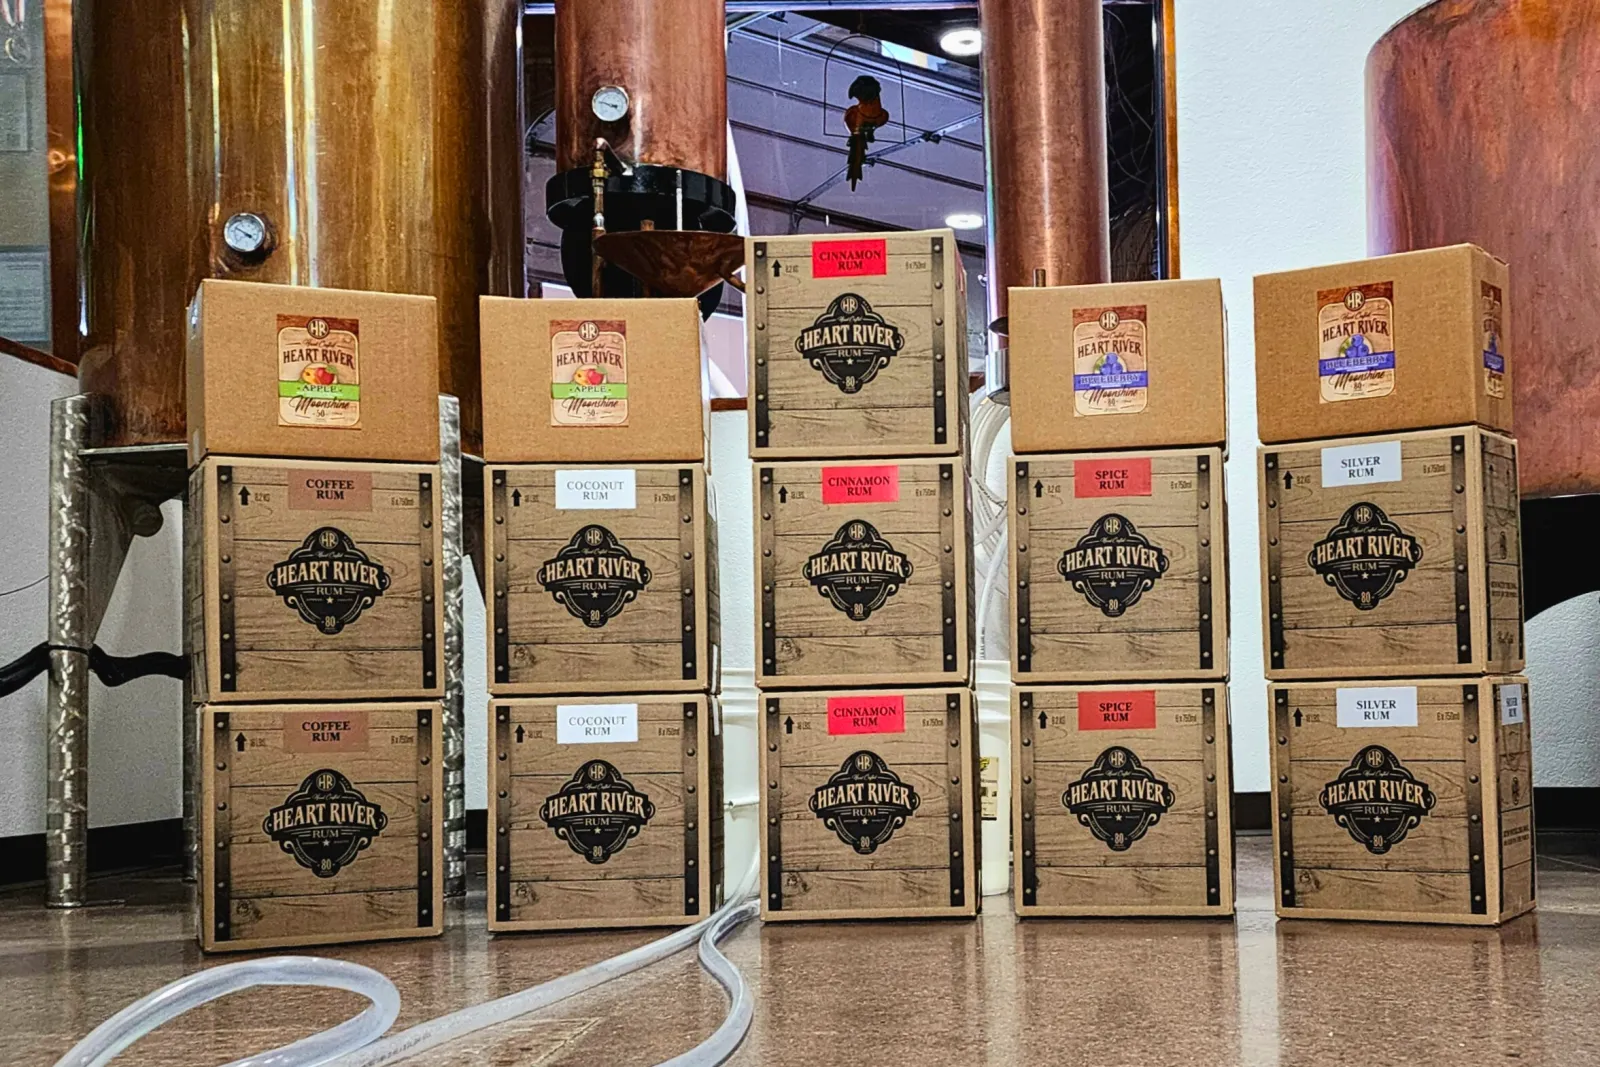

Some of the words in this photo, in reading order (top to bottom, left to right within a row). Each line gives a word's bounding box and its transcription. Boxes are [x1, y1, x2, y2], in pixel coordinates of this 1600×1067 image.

[819, 250, 881, 261] CINNAMON
[838, 260, 862, 269] RUM
[842, 298, 856, 312] HR
[1347, 291, 1362, 308] HR
[1101, 312, 1117, 328] HR
[310, 319, 327, 336] HR
[581, 323, 597, 338] HR
[1323, 322, 1355, 342] HEART
[1358, 318, 1390, 336] RIVER
[804, 325, 850, 350] HEART
[853, 323, 896, 352] RIVER
[838, 349, 861, 358] RUM
[1078, 340, 1109, 358] HEART
[1112, 339, 1143, 356] RIVER
[283, 348, 319, 363] HEART
[322, 349, 355, 370] RIVER
[556, 350, 589, 367] HEART
[592, 350, 623, 369] RIVER
[845, 376, 855, 387] 80
[1328, 370, 1385, 390] Moonshine
[1083, 386, 1138, 405] Moonshine
[288, 396, 350, 414] Moonshine
[562, 396, 618, 414] Moonshine
[1341, 456, 1381, 468] SILVER
[1095, 470, 1128, 480] SPICE
[1348, 468, 1374, 478] RUM
[306, 479, 354, 489] COFFEE
[567, 481, 624, 491] COCONUT
[828, 476, 890, 486] CINNAMON
[1100, 480, 1124, 489] RUM
[316, 490, 344, 499] RUM
[583, 491, 608, 500] RUM
[847, 487, 872, 496] RUM
[1356, 507, 1371, 523] HR
[850, 524, 864, 539] HR
[1105, 518, 1120, 533] HR
[321, 532, 337, 548] HR
[586, 530, 601, 544] HR
[1316, 536, 1365, 565] HEART
[1367, 532, 1414, 565] RIVER
[811, 552, 858, 577] HEART
[861, 550, 905, 578] RIVER
[1066, 546, 1113, 573] HEART
[1116, 544, 1160, 574] RIVER
[546, 558, 595, 583] HEART
[598, 556, 643, 585] RIVER
[1352, 562, 1377, 572] RUM
[276, 560, 330, 587] HEART
[333, 560, 381, 590] RIVER
[846, 576, 870, 585] RUM
[1101, 571, 1125, 580] RUM
[316, 587, 343, 596] RUM
[582, 582, 607, 591] RUM
[1360, 591, 1371, 604] 80
[854, 603, 864, 615] 80
[1108, 599, 1119, 610] 80
[590, 610, 601, 621] 80
[325, 616, 336, 628] 80
[1099, 702, 1132, 712] SPICE
[1356, 700, 1396, 710] SILVER
[834, 707, 896, 717] CINNAMON
[1103, 713, 1128, 722] RUM
[1364, 711, 1390, 720] RUM
[302, 721, 350, 731] COFFEE
[569, 716, 627, 726] COCONUT
[853, 718, 878, 726] RUM
[312, 732, 340, 742] RUM
[585, 727, 610, 735] RUM
[857, 756, 871, 770] HR
[1110, 751, 1125, 766] HR
[1367, 751, 1382, 766] HR
[590, 765, 604, 780] HR
[318, 774, 334, 790] HR
[818, 784, 865, 810] HEART
[868, 781, 912, 811] RIVER
[1071, 780, 1119, 805] HEART
[1121, 778, 1166, 807] RIVER
[1328, 780, 1377, 806] HEART
[1379, 779, 1427, 809] RIVER
[549, 793, 598, 819] HEART
[601, 790, 646, 820] RIVER
[1106, 805, 1130, 813] RUM
[1364, 806, 1389, 815] RUM
[273, 804, 326, 832] HEART
[330, 801, 378, 832] RIVER
[852, 808, 876, 817] RUM
[585, 817, 610, 826] RUM
[312, 829, 339, 839] RUM
[1114, 833, 1124, 844] 80
[860, 836, 870, 848] 80
[1373, 835, 1384, 847] 80
[593, 845, 603, 857] 80
[321, 858, 332, 871] 80
